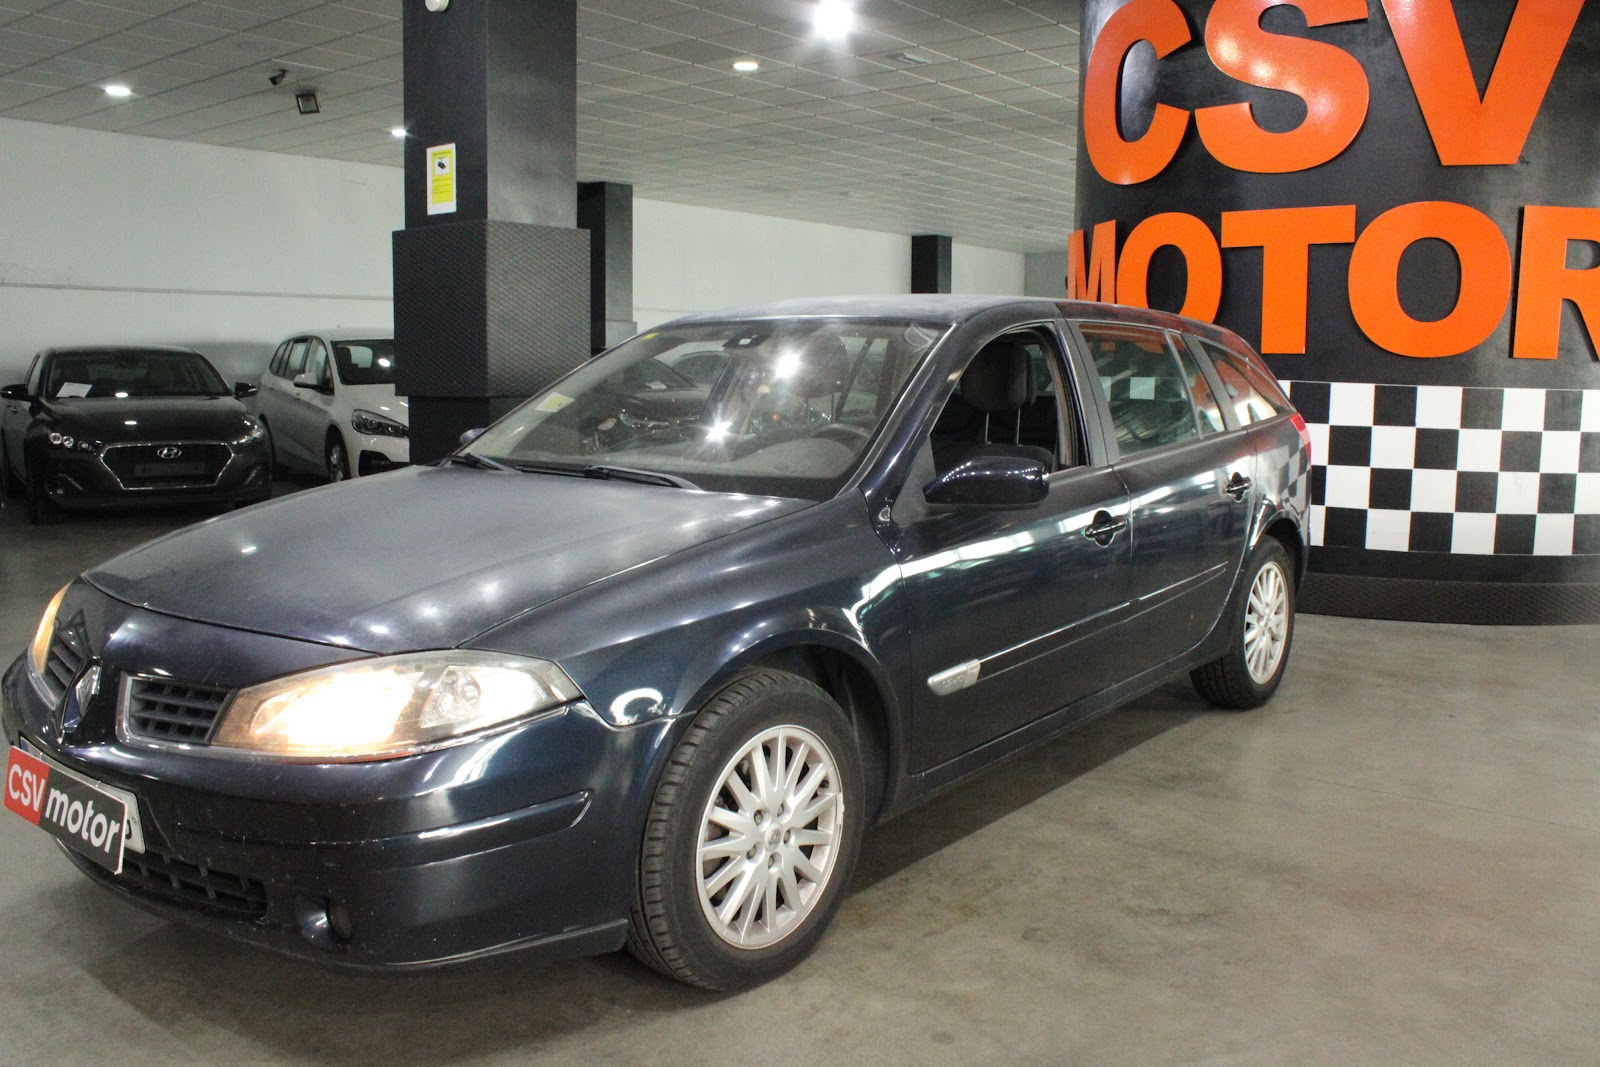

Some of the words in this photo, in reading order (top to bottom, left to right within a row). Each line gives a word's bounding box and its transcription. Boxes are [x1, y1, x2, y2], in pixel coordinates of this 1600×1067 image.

[1083, 0, 1585, 185] CSV
[1067, 201, 1600, 361] MOTOR
[8, 763, 46, 813] CSV
[45, 787, 121, 854] motor
